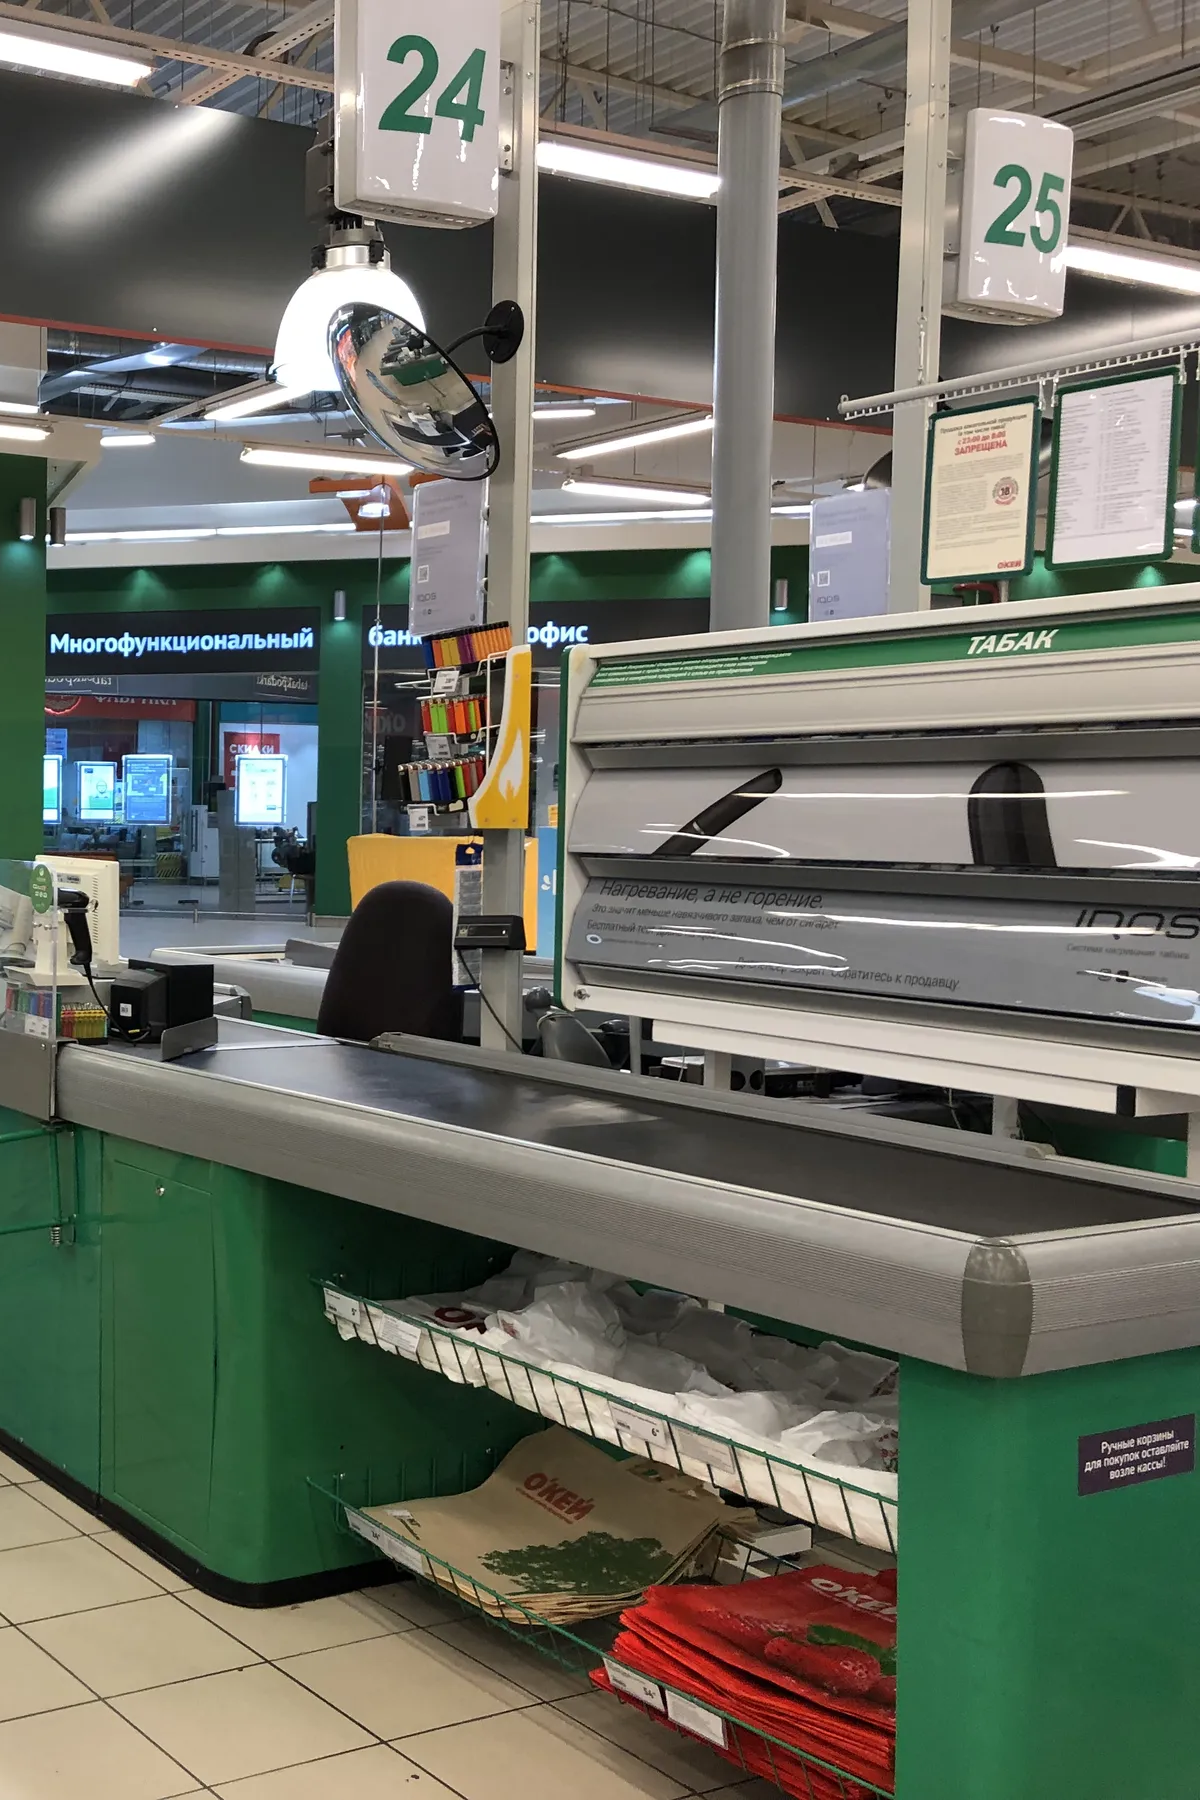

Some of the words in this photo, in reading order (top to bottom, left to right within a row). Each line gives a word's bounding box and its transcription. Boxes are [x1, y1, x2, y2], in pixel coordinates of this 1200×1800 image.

[378, 34, 486, 142] 24
[984, 164, 1065, 254] 25
[954, 439, 1007, 456] ЗАПРЕЩЕНА
[49, 627, 314, 658] Многофункциональный
[527, 621, 588, 648] офис
[967, 628, 1060, 655] ТАБАК
[599, 879, 699, 903] Нагревание,
[703, 891, 714, 903] а
[718, 892, 741, 905] не
[744, 891, 824, 910] горение.
[586, 919, 636, 934] Бесплатный
[591, 903, 606, 913] Это
[607, 906, 636, 916] значит
[637, 907, 671, 917] меньше
[671, 910, 728, 922] навязчивого
[765, 916, 784, 926] чем
[785, 918, 798, 927] от
[799, 917, 841, 931] сигарет
[894, 975, 902, 984] к
[1084, 1459, 1102, 1473] для
[1103, 1449, 1140, 1467] покупок
[1141, 1438, 1190, 1459] оставляйте
[1100, 1437, 1136, 1455] Ручные
[1136, 1429, 1175, 1447] корзины
[1109, 1464, 1136, 1480] возле
[1136, 1455, 1166, 1474] кассы!
